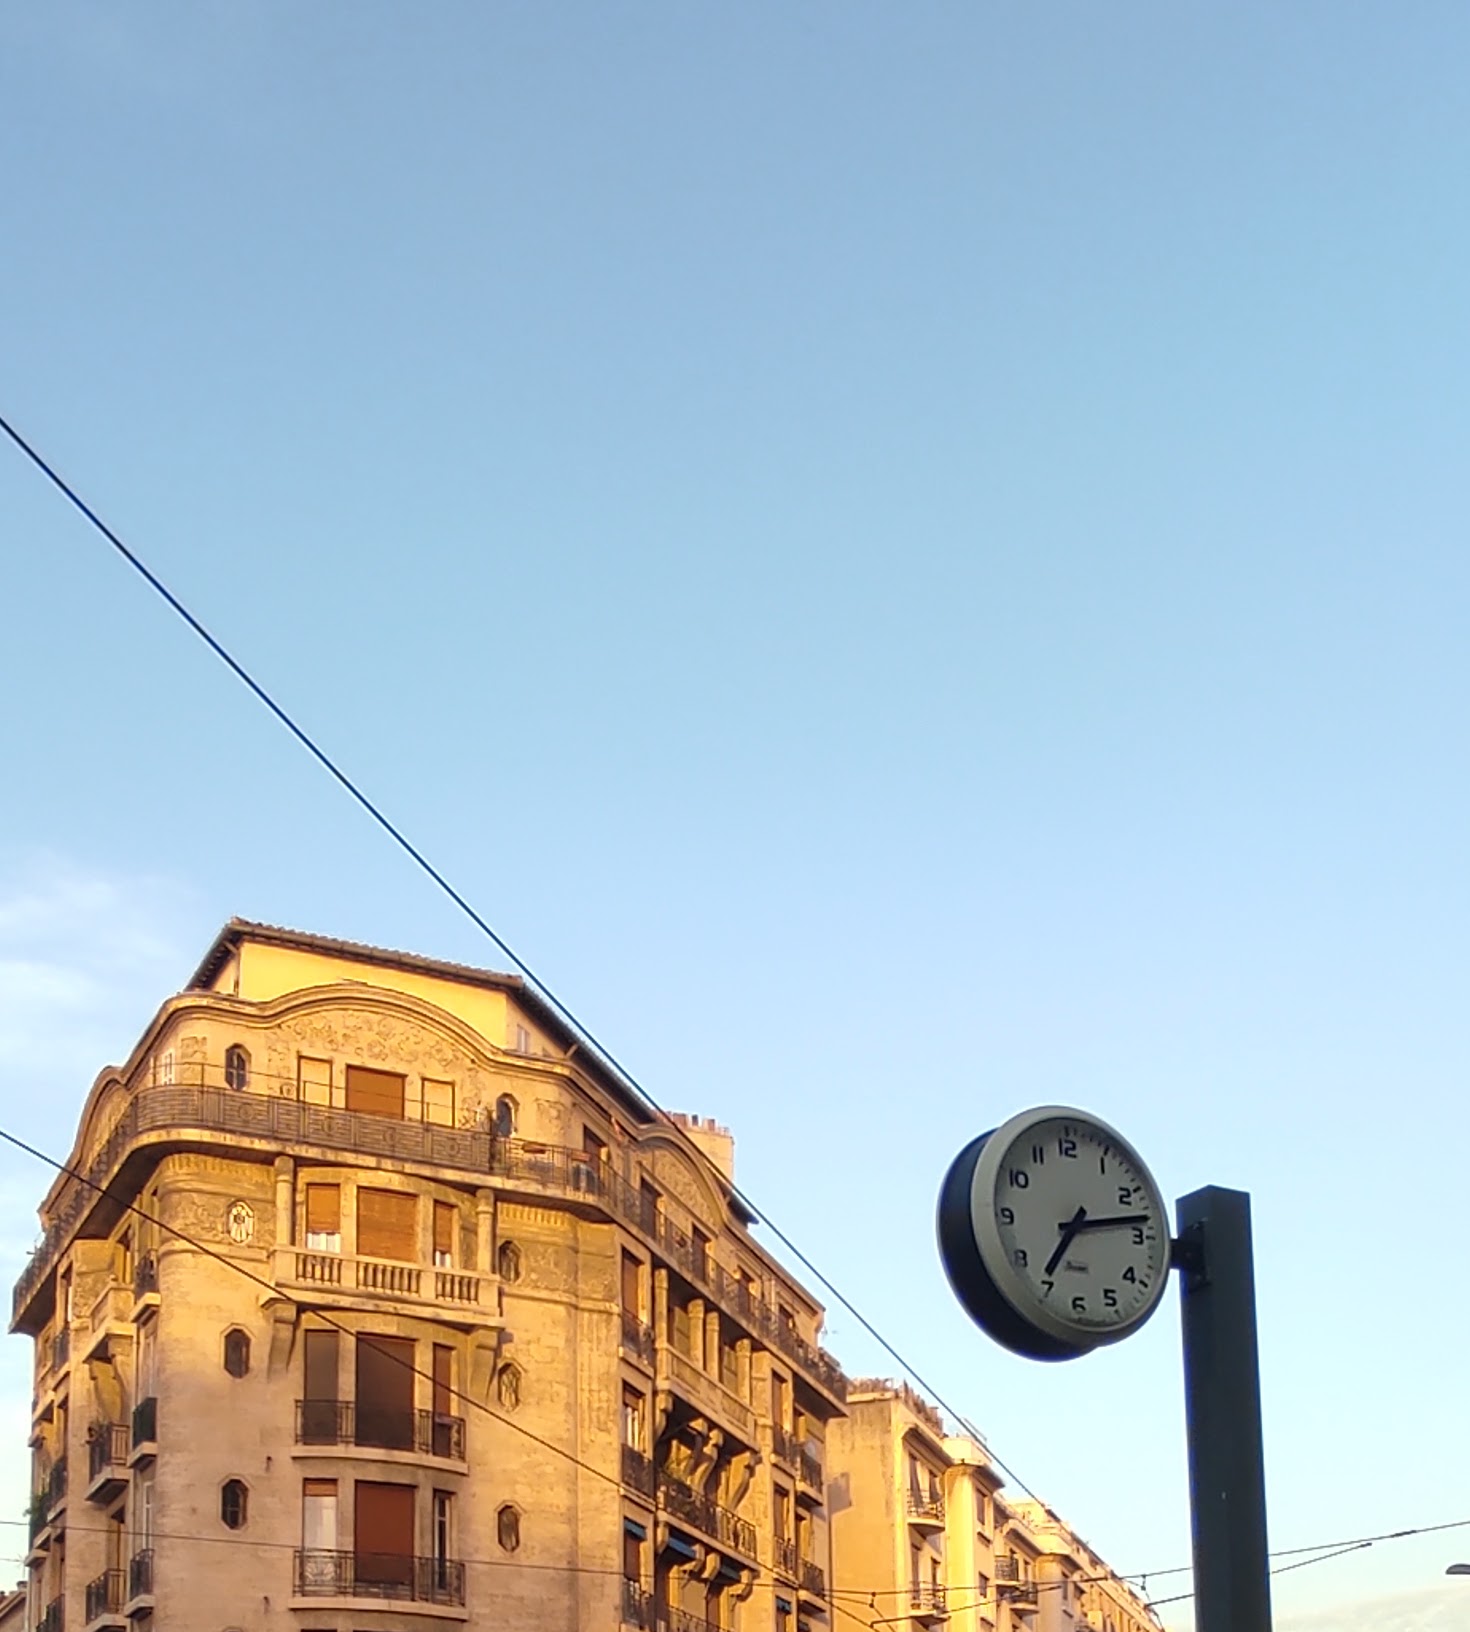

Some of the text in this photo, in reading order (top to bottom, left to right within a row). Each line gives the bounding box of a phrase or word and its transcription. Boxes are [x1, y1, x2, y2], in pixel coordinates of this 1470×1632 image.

[1032, 1145, 1044, 1165] 11
[1058, 1138, 1077, 1159] 12
[1100, 1157, 1106, 1175] 1
[1009, 1169, 1029, 1189] 10
[1118, 1187, 1132, 1206] 2
[1000, 1208, 1015, 1225] 9
[1132, 1228, 1145, 1246] 3
[1014, 1250, 1028, 1268] 8
[1122, 1266, 1136, 1284] 4
[1041, 1280, 1054, 1299] 7
[1103, 1288, 1117, 1307] 5
[1072, 1297, 1086, 1314] 6
